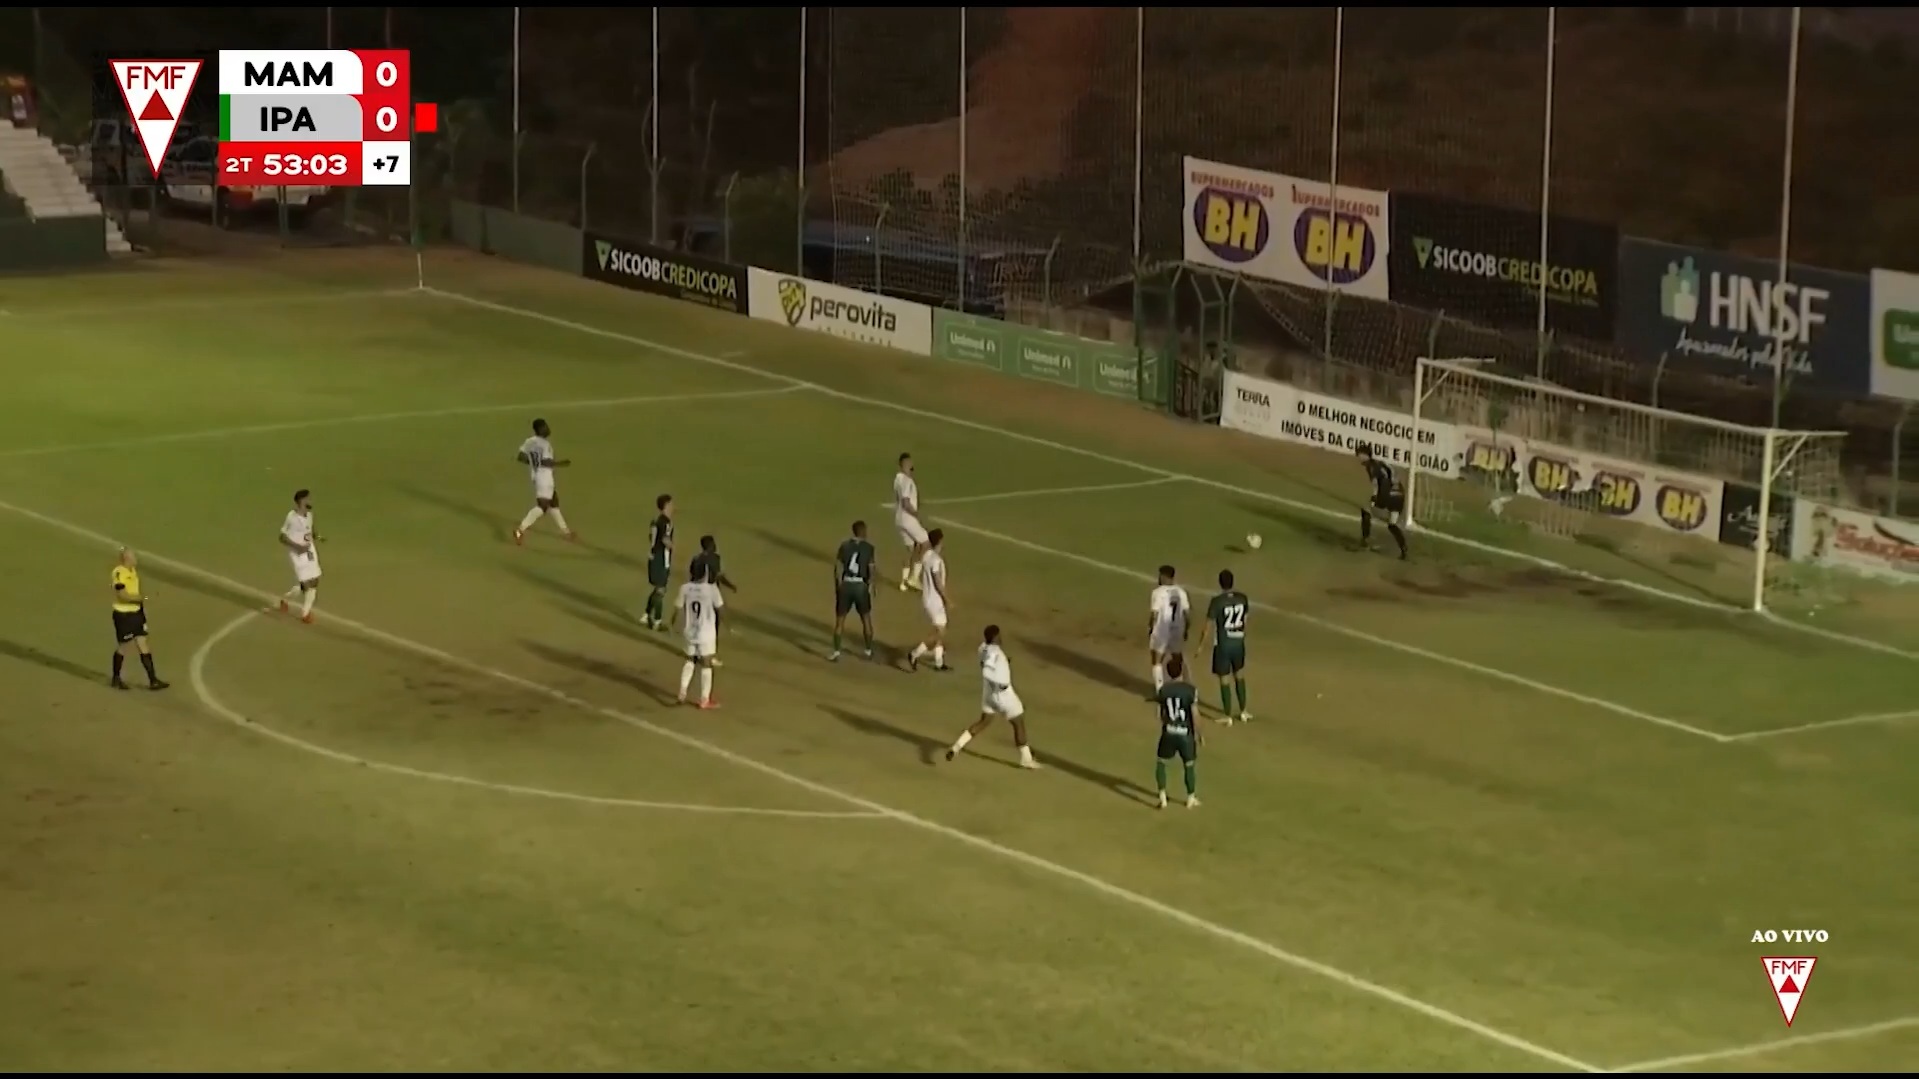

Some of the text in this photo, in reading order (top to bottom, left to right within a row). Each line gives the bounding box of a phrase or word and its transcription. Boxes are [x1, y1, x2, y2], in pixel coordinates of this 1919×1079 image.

[1204, 193, 1261, 251] BH
[1305, 215, 1366, 272] BH
[1433, 245, 1598, 296] SICOOBCREDCOPA
[810, 295, 896, 332] perovita
[1709, 271, 1830, 344] HNSF
[1236, 386, 1270, 408] TERRA
[1297, 400, 1306, 414] O
[1309, 403, 1357, 427] MELHOR
[1417, 428, 1436, 445] EM
[1328, 431, 1343, 447] DA
[1393, 447, 1401, 461] E
[1403, 450, 1449, 472] RGIÃO
[1534, 459, 1571, 492] BH
[1662, 488, 1702, 525] BH
[692, 601, 701, 619] 9
[1170, 601, 1178, 621] 7
[1224, 603, 1244, 628] 22
[1166, 697, 1186, 722] 14
